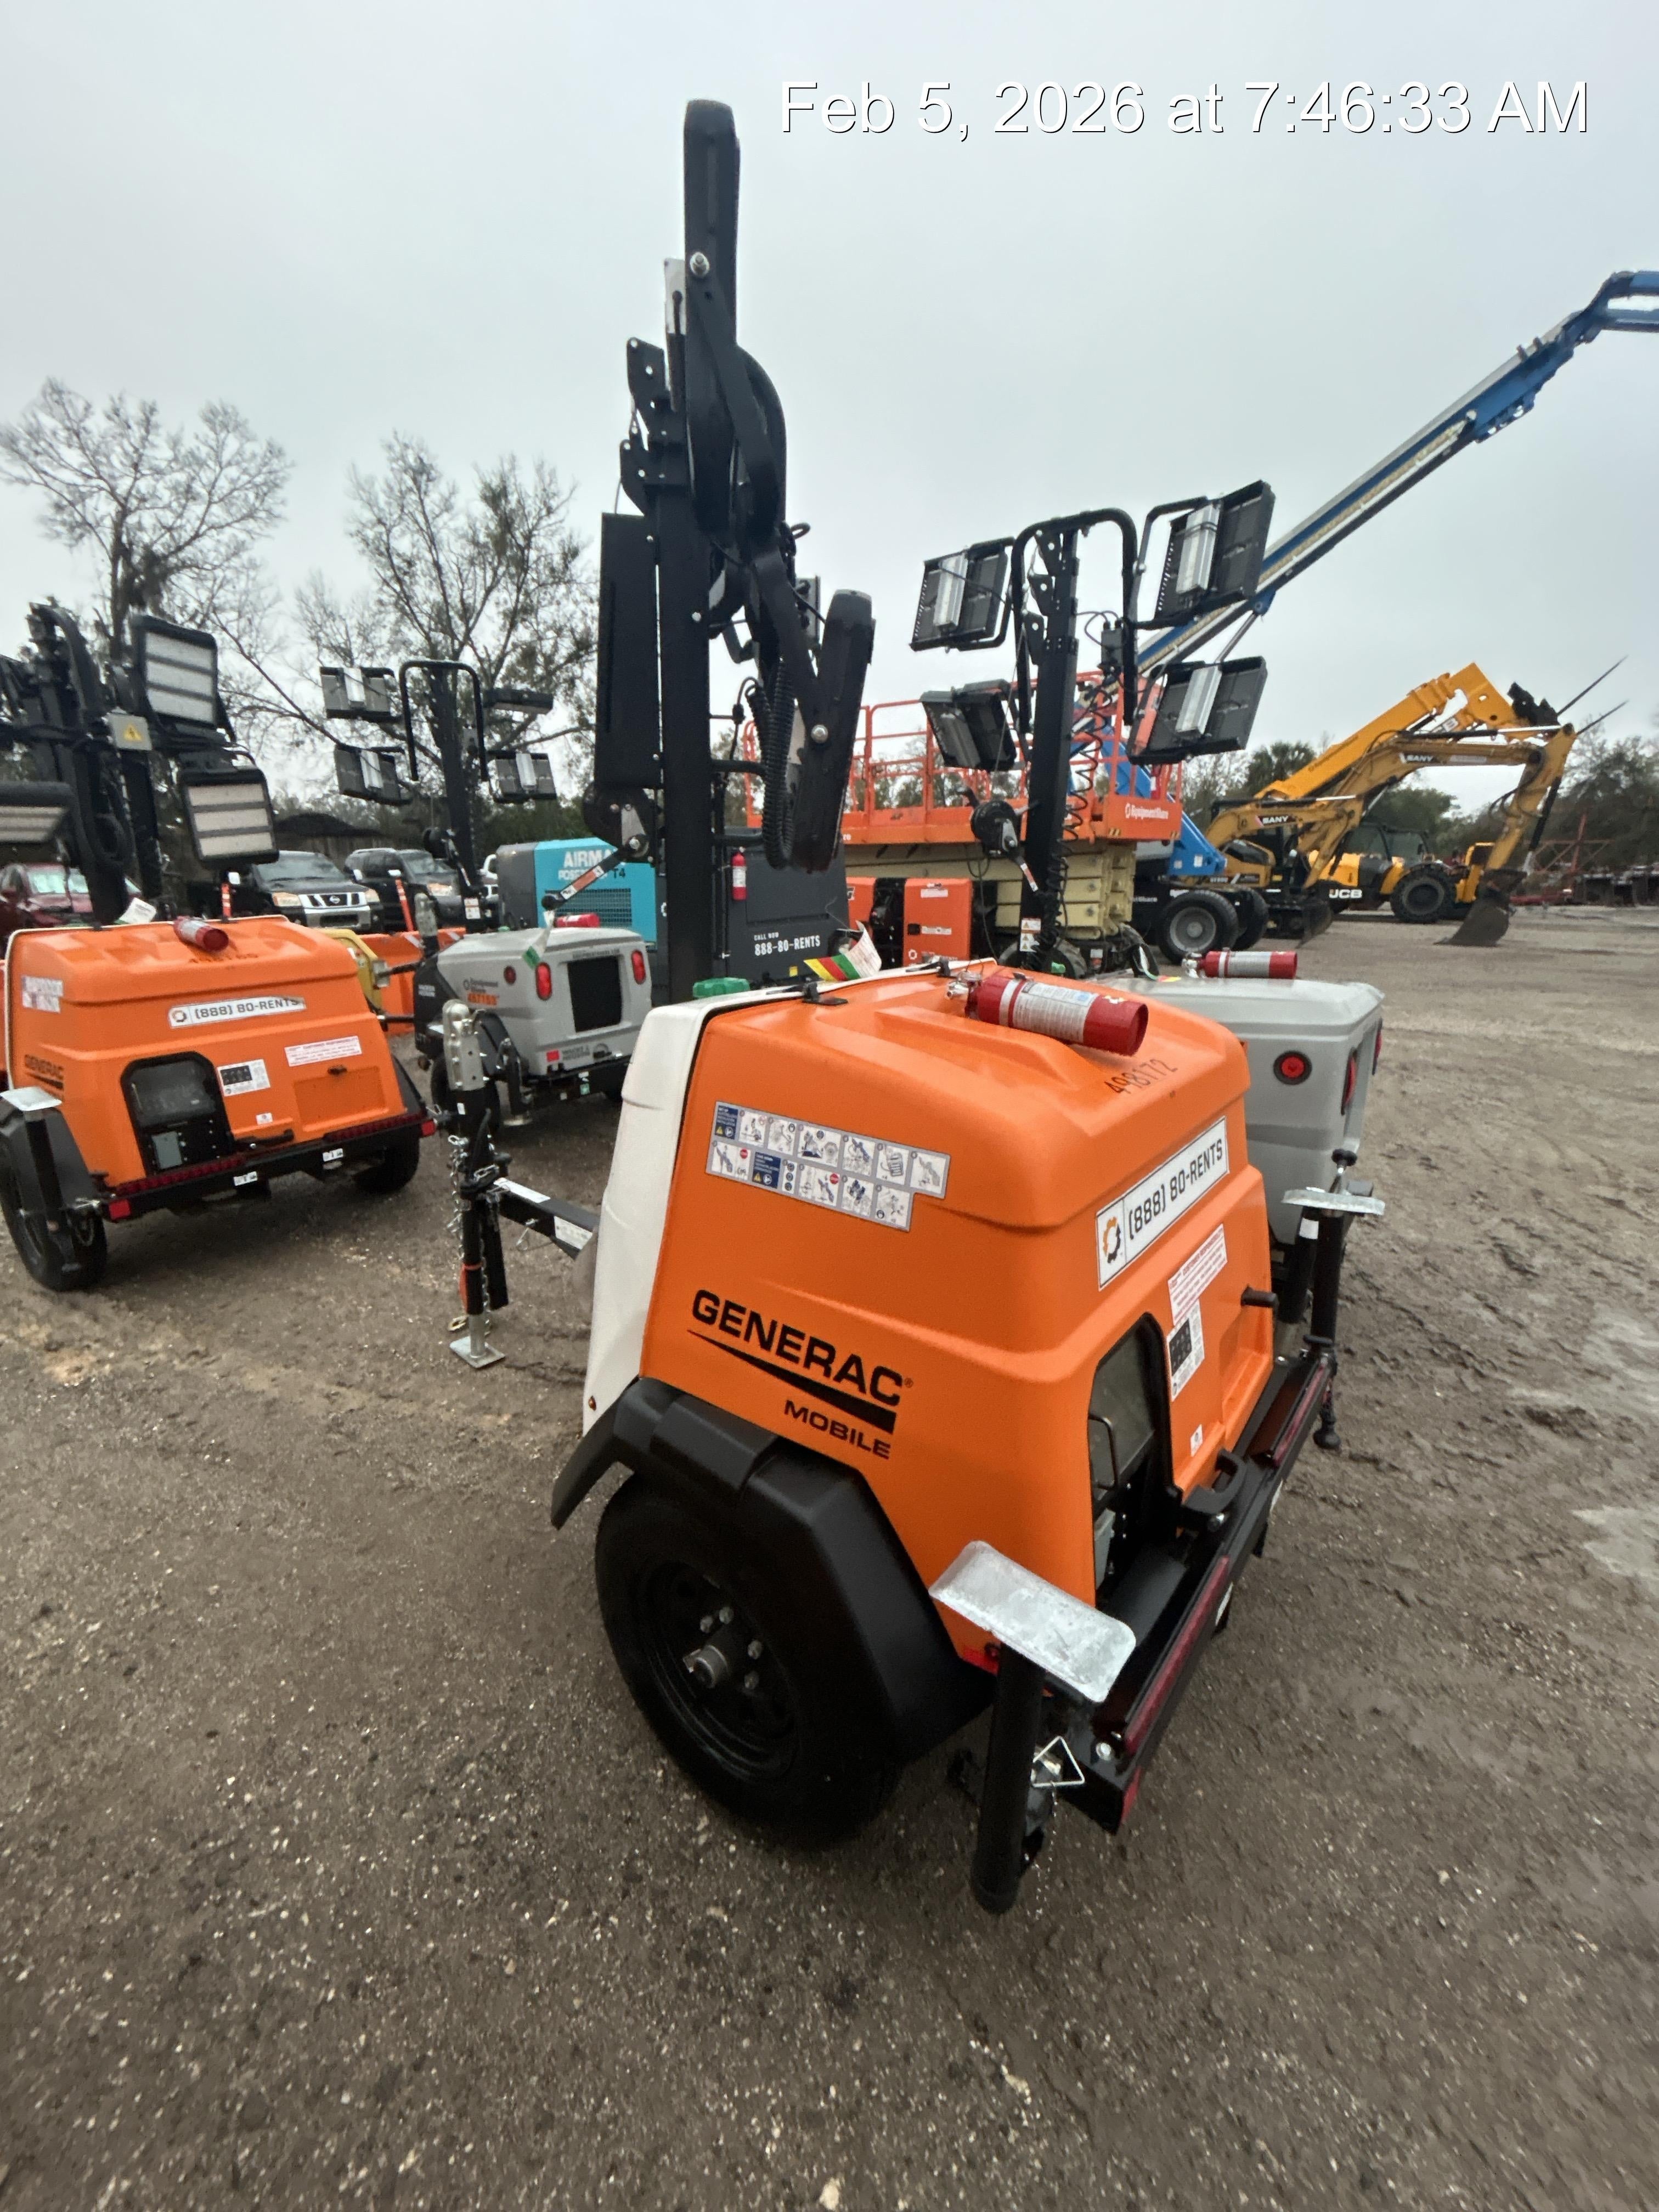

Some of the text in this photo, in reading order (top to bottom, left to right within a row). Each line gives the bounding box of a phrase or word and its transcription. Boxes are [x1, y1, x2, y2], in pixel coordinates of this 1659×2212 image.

[1262, 815, 1289, 823] SANY
[563, 849, 612, 868] AIRMA
[1329, 889, 1362, 899] JCB
[754, 935, 821, 956] 888-80-RENTS
[195, 1005, 233, 1019] (888)
[1104, 1059, 1178, 1094] 498172
[1128, 1138, 1222, 1240] (888) 80-RENTS
[784, 1400, 891, 1460] MOBILE
